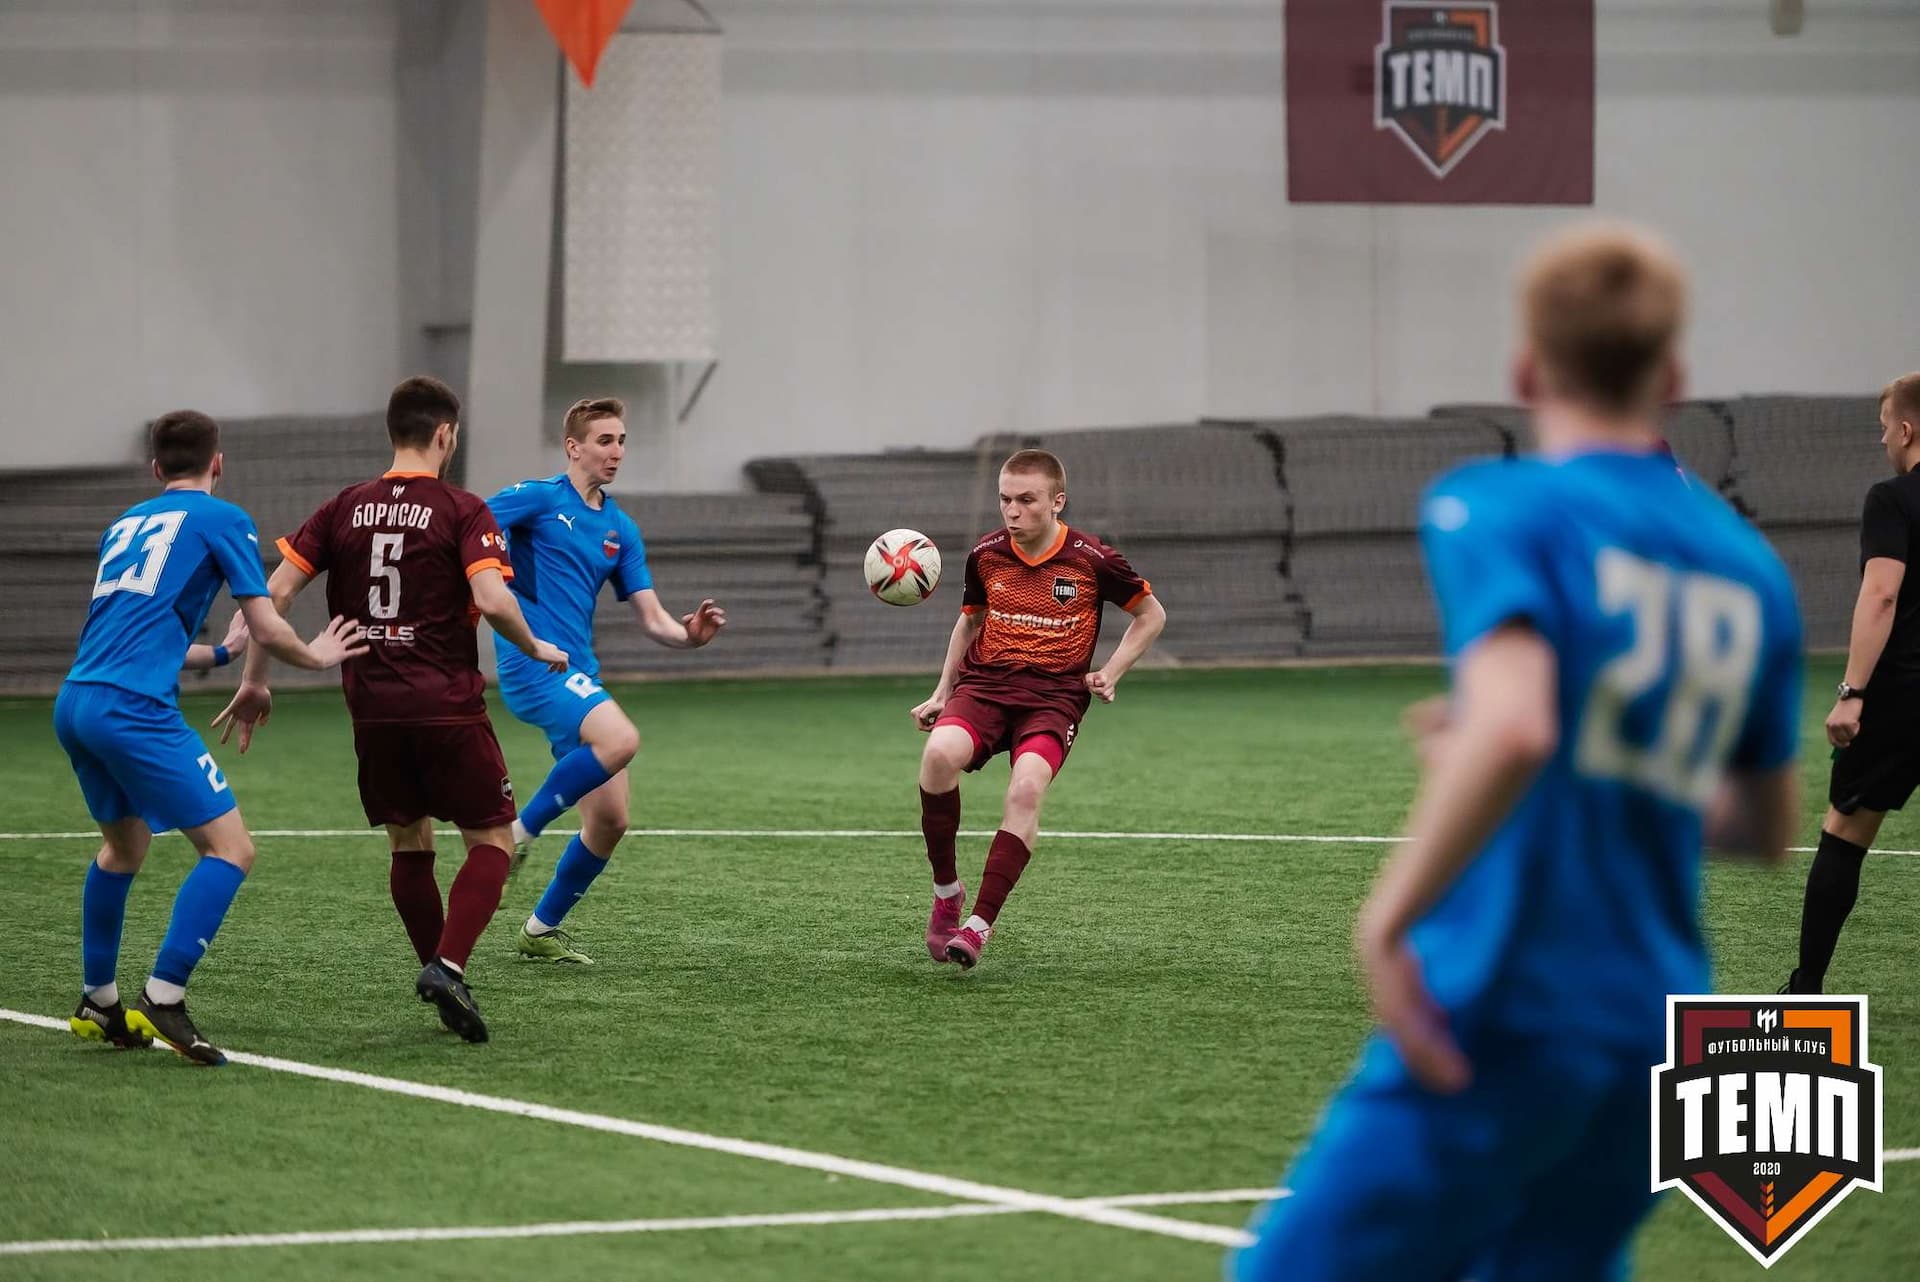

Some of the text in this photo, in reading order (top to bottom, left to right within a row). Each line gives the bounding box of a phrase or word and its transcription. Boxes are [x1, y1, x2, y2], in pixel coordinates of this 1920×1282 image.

[1388, 50, 1494, 111] ТЕМП
[352, 503, 433, 530] БОРИСОВ
[92, 510, 188, 600] 23
[368, 532, 405, 619] 5
[1055, 585, 1076, 597] ТЕМП
[1574, 545, 1763, 809] 28
